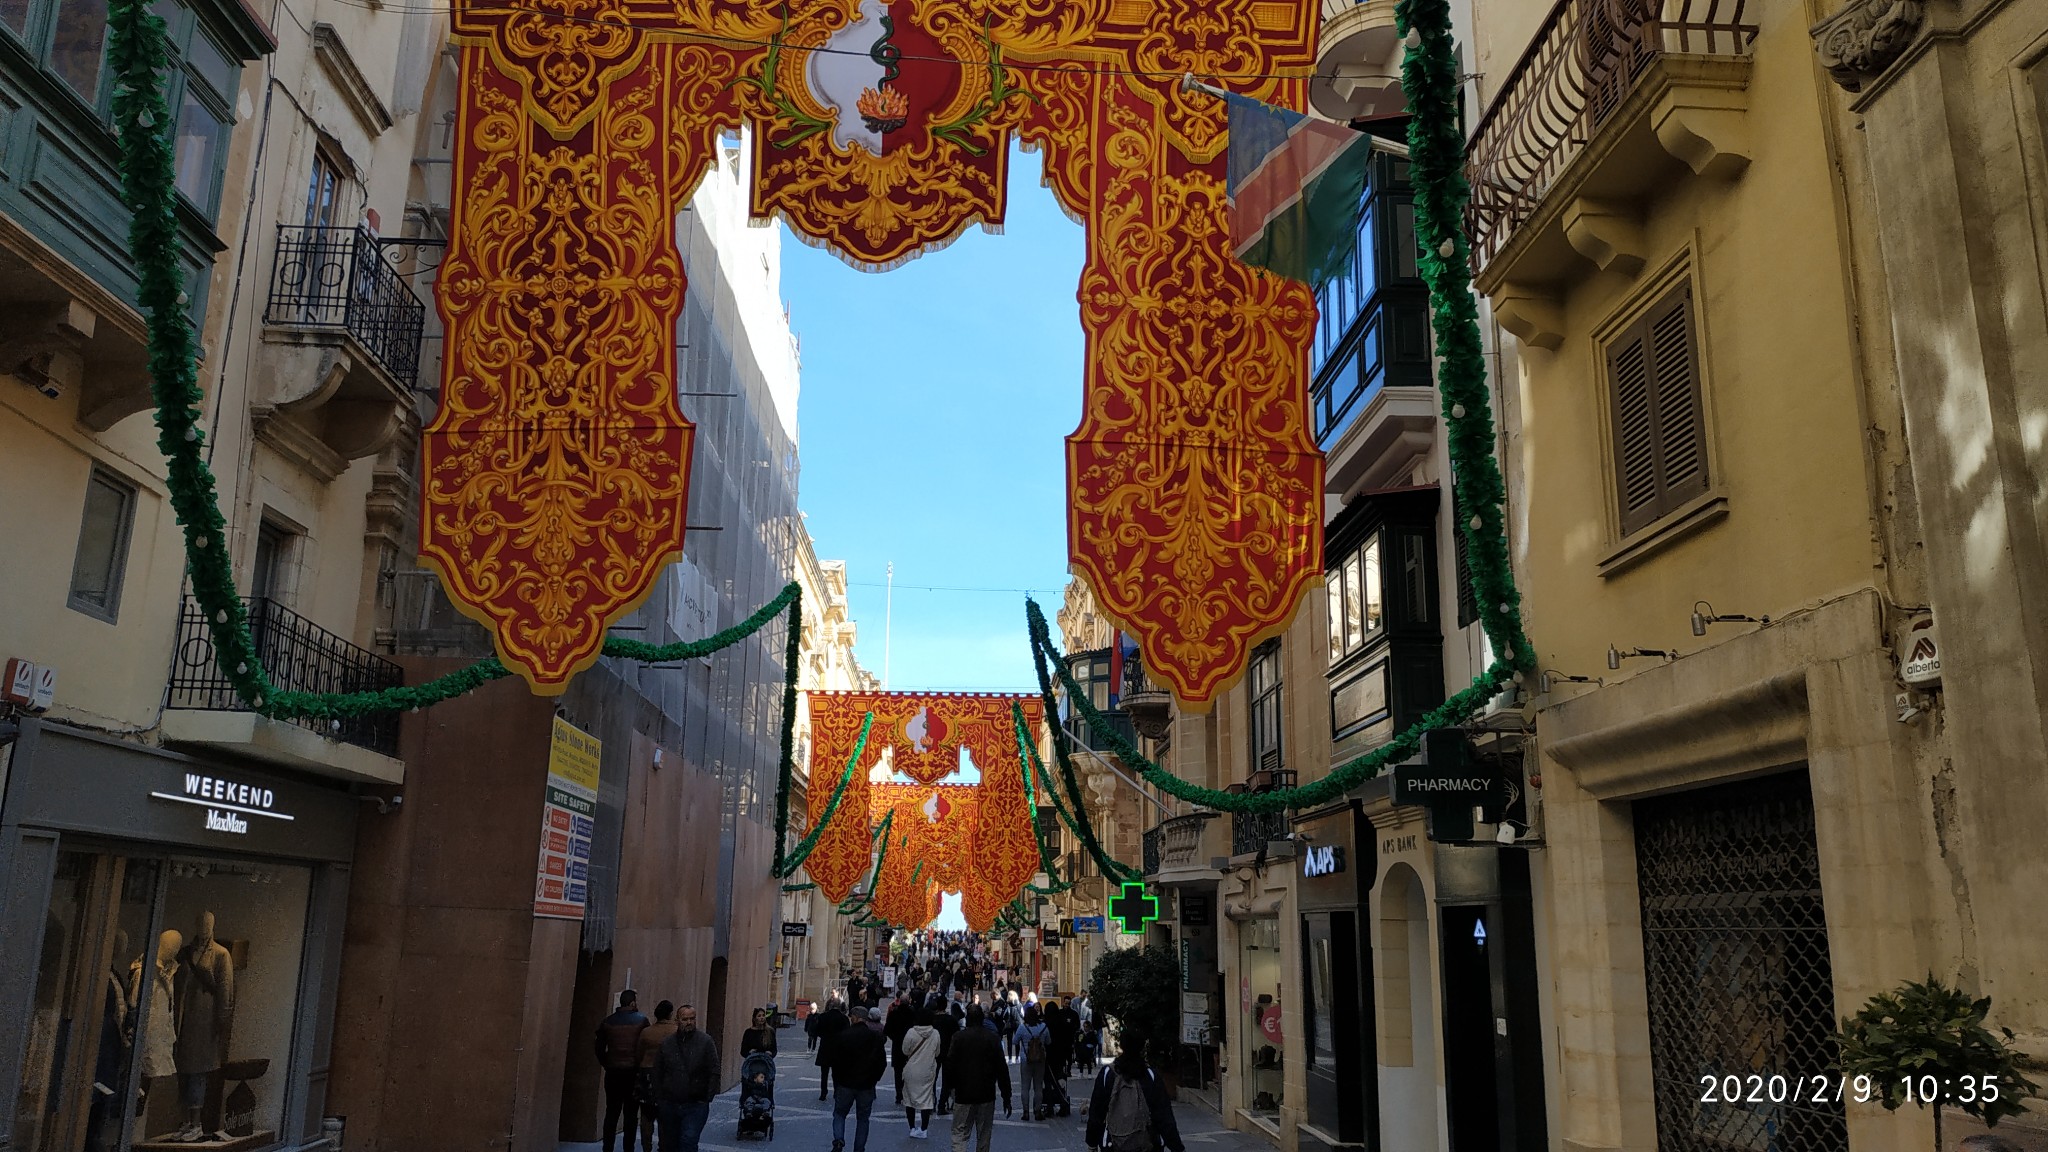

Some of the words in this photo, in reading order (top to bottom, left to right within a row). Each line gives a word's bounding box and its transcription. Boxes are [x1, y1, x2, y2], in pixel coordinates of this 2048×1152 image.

[1907, 660, 1941, 675] alberta
[185, 773, 274, 808] WEEKEND
[1407, 778, 1491, 791] PHARMACY
[553, 791, 568, 805] SITE
[568, 796, 591, 813] SAFETY
[206, 808, 248, 834] MaxMara
[1382, 839, 1395, 855] APS
[1397, 835, 1418, 853] BANK
[1316, 845, 1335, 875] APS
